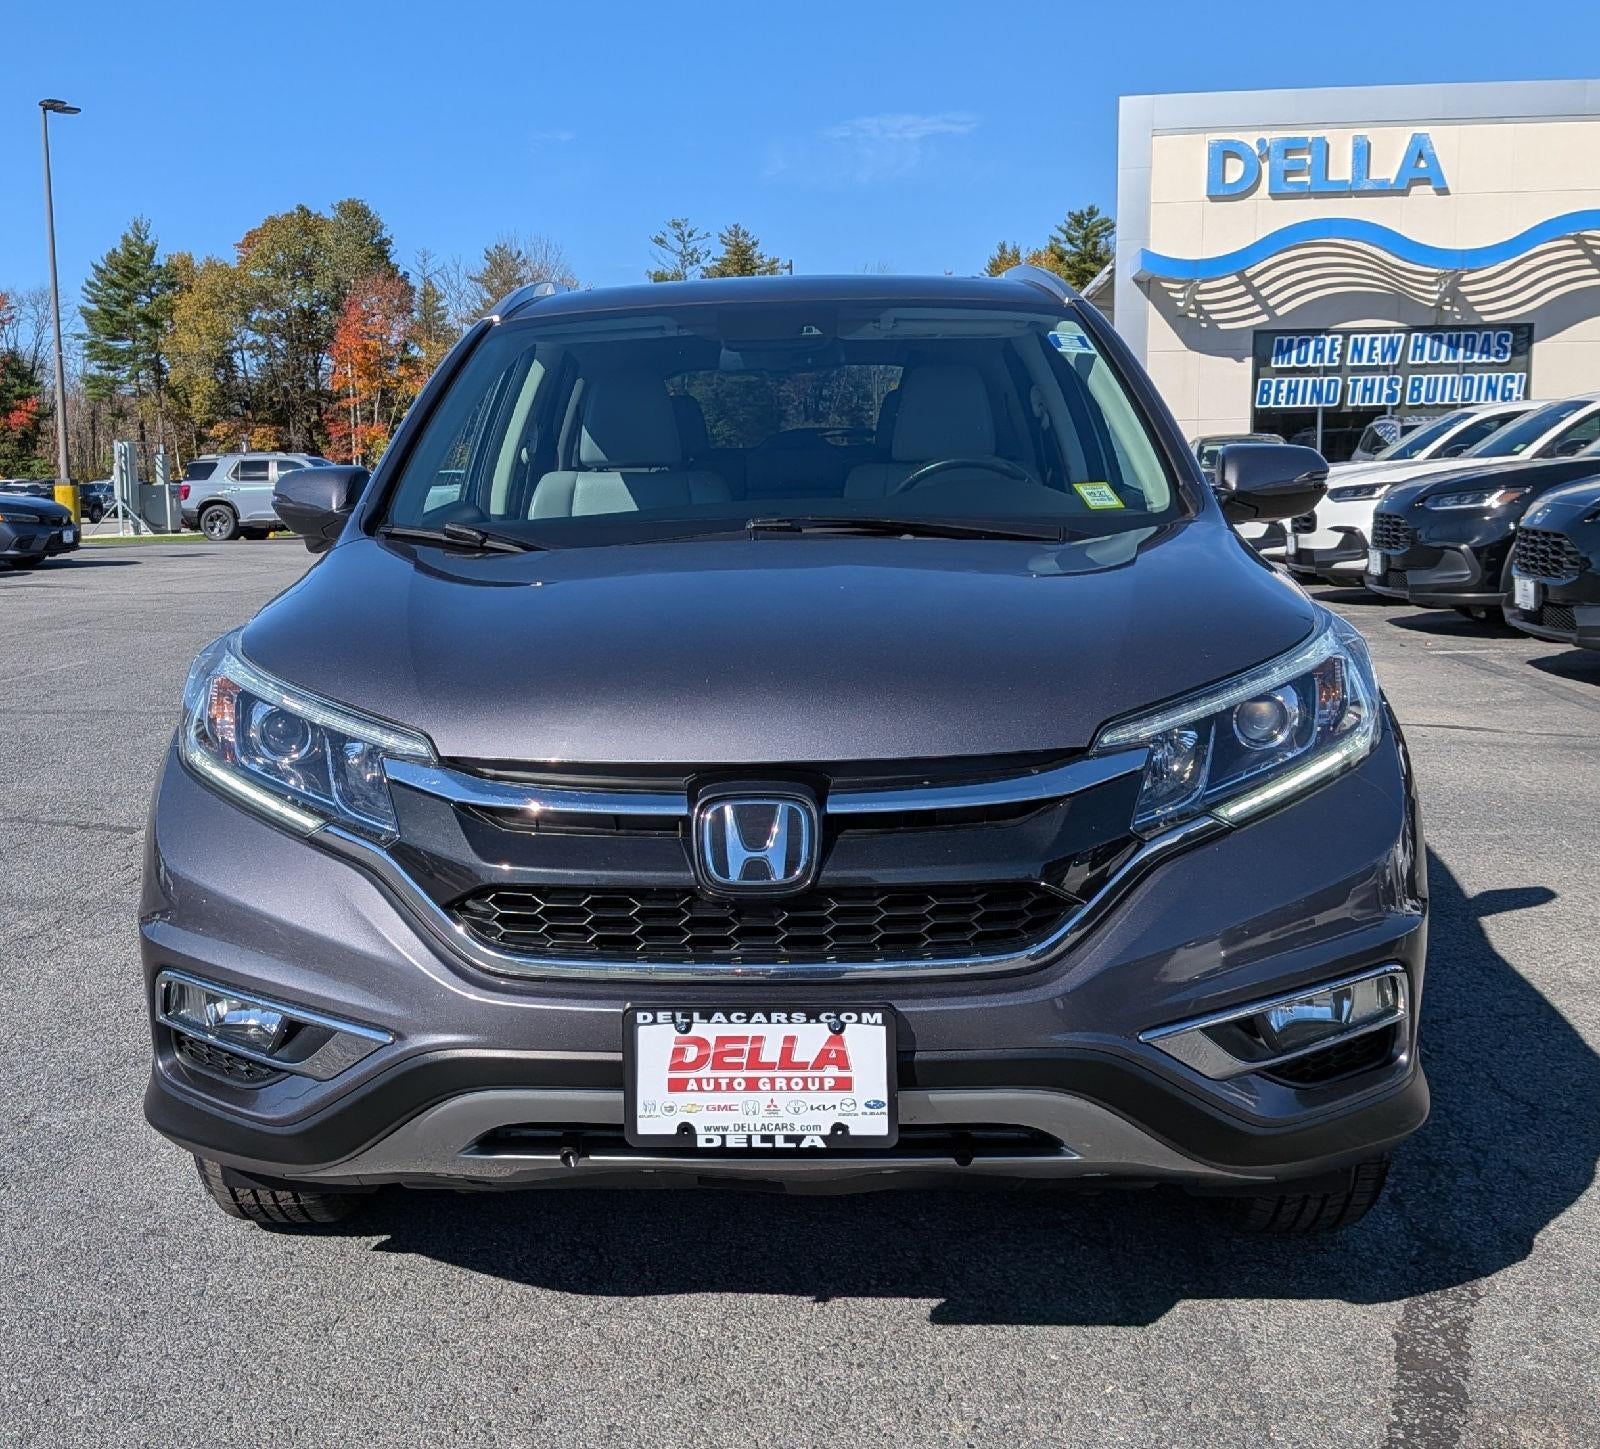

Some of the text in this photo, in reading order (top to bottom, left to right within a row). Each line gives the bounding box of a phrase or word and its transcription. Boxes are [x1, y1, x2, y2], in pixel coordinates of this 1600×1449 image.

[1206, 131, 1451, 199] D'ELLA
[1271, 331, 1513, 368] MORE NEW HONDAS
[1255, 373, 1527, 408] BEHIND THIS BUILDING!
[636, 1012, 883, 1025] DELLACARS.COM
[668, 1034, 853, 1072] DELLA
[686, 1076, 836, 1091] AUTO GROUP
[706, 1103, 739, 1112] GMC
[703, 1122, 822, 1132] www.DELLACARS.com
[696, 1134, 827, 1148] DELLA
